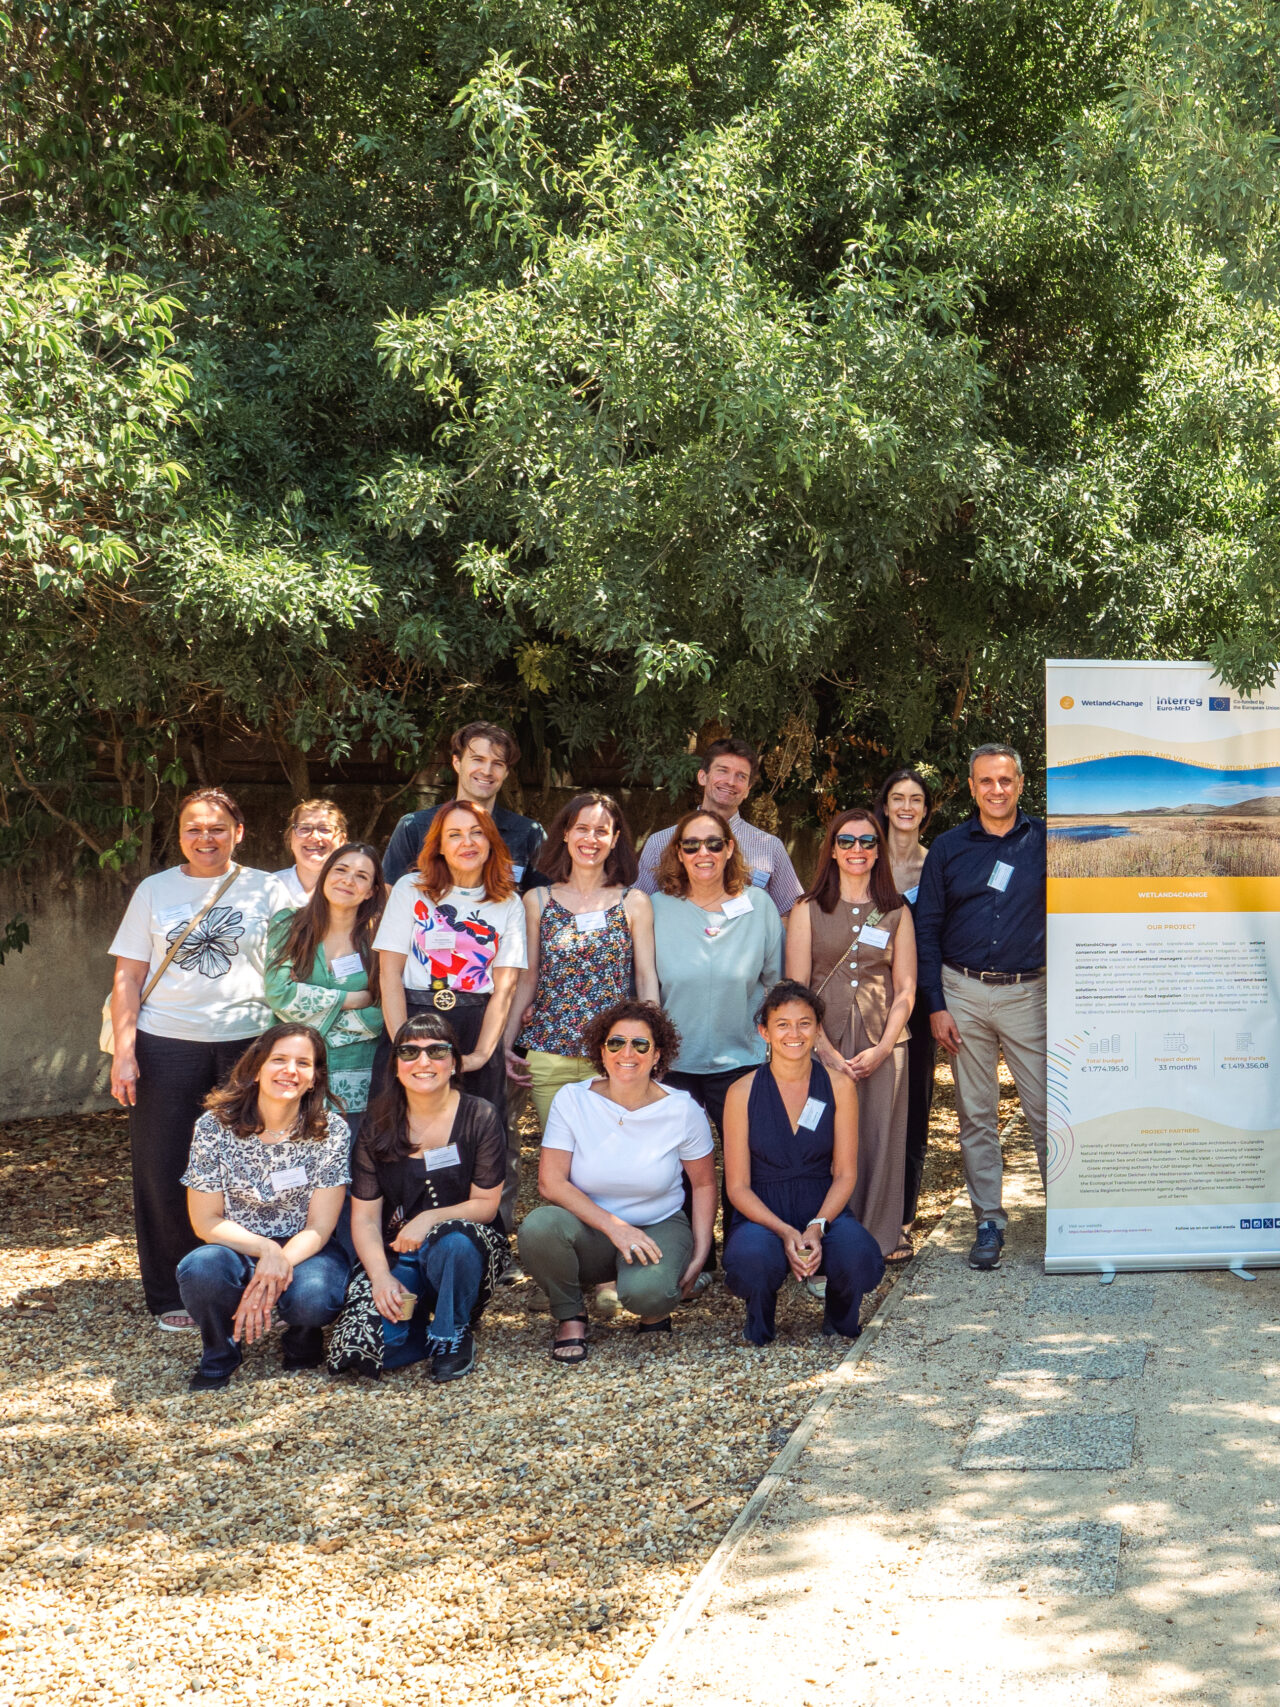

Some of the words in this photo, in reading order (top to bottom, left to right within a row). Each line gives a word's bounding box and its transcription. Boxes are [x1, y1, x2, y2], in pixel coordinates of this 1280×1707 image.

[1081, 700, 1144, 708] Wetland4Change
[1108, 750, 1152, 758] RESTORING
[1154, 752, 1172, 760] AND
